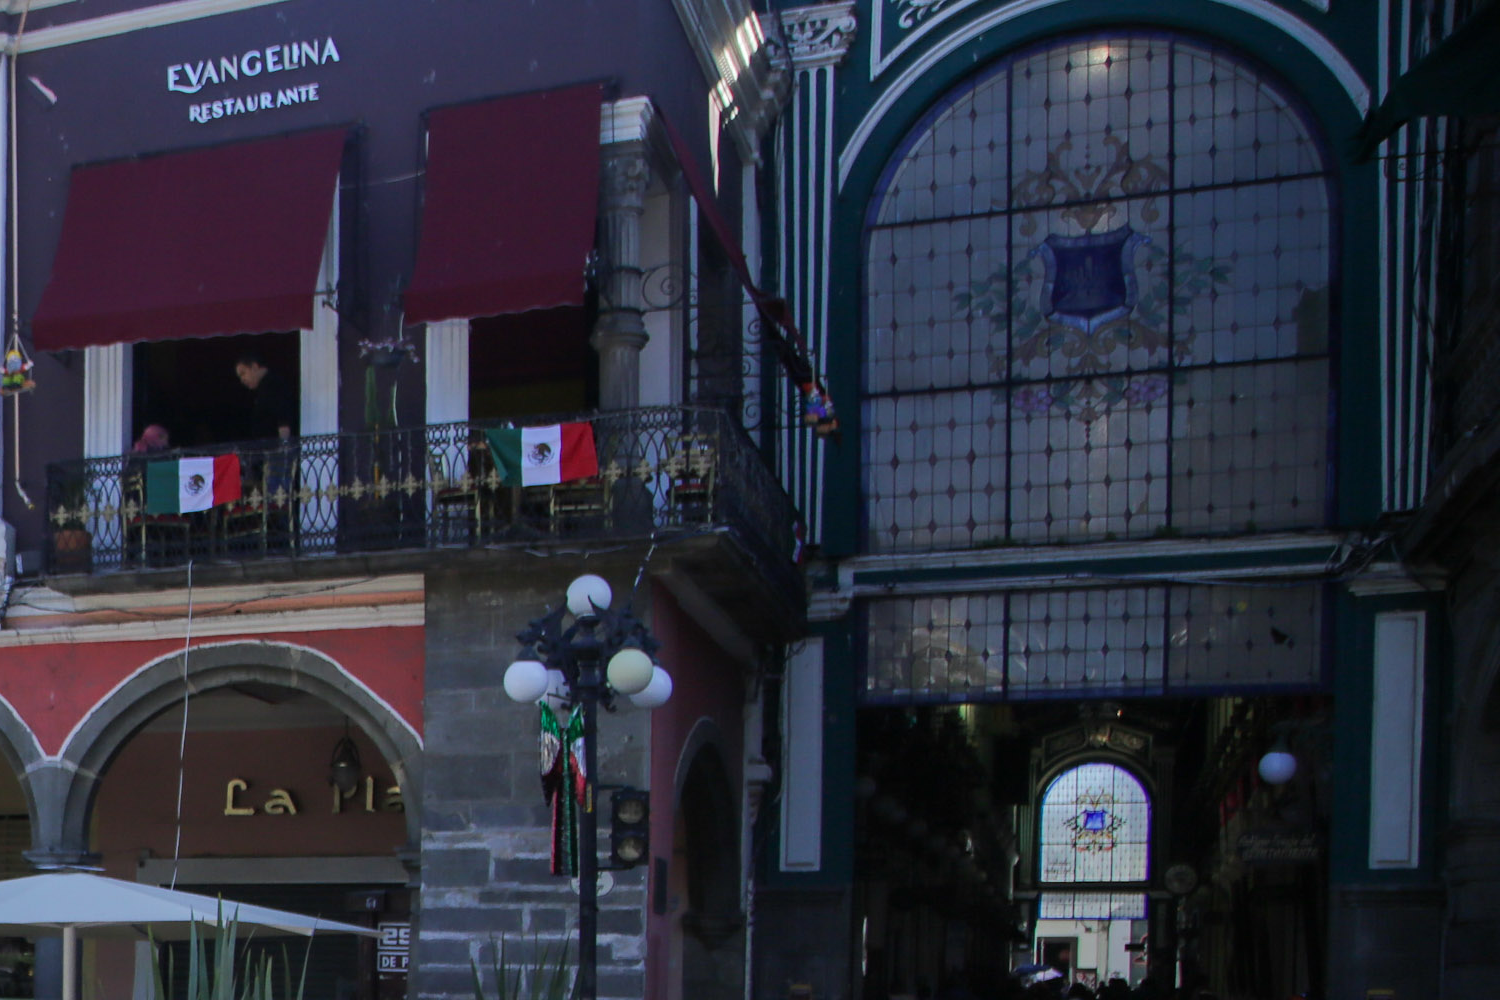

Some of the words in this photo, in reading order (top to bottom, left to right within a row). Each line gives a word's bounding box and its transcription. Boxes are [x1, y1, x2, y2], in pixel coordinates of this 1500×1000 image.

[167, 36, 340, 94] EVANGELINA
[188, 83, 320, 124] RESTAURANTE
[224, 778, 298, 816] La
[381, 956, 397, 968] DE
